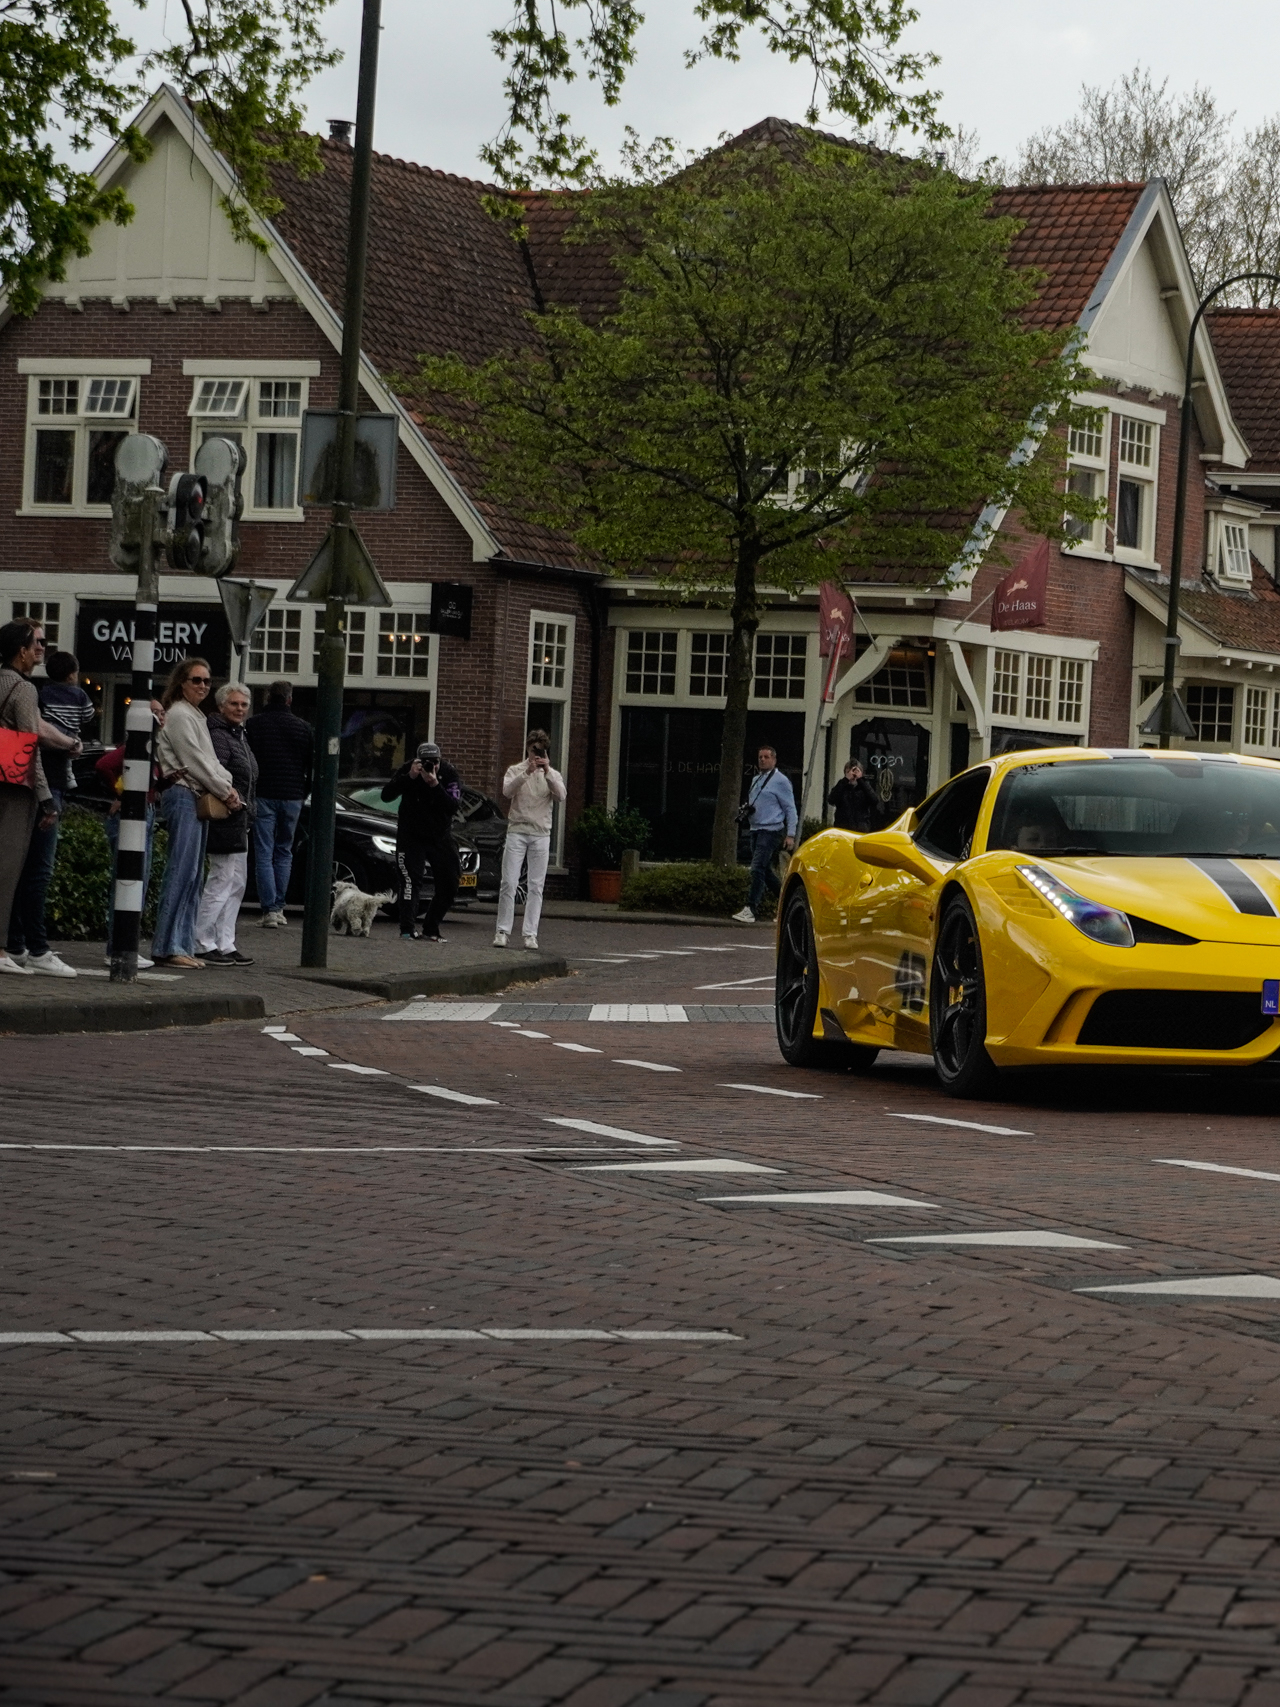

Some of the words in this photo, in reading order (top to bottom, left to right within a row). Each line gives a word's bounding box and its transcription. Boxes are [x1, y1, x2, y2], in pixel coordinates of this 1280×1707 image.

[998, 602, 1009, 613] De
[1011, 600, 1036, 611] Haas
[111, 646, 133, 660] VA
[696, 762, 721, 774] HAA
[1265, 1000, 1276, 1008] NL
